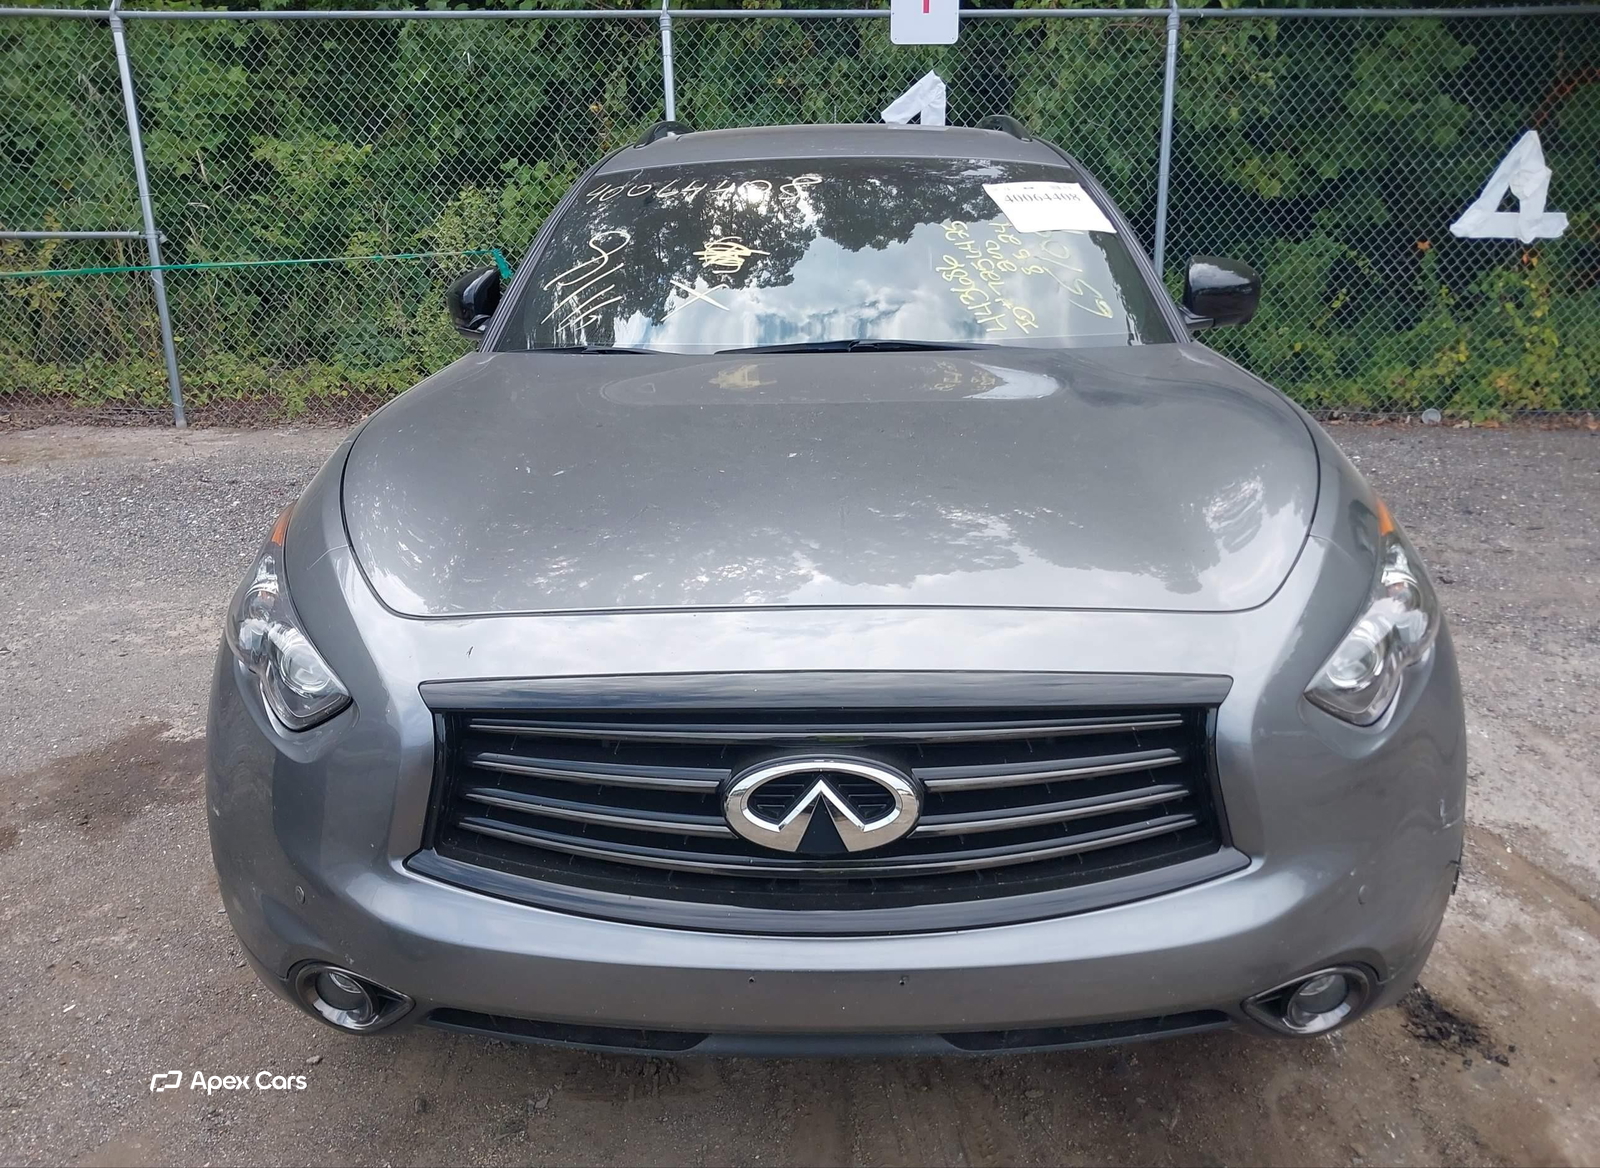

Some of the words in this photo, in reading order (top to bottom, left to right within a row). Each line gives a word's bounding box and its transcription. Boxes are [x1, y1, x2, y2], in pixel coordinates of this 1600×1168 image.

[585, 176, 823, 204] 40064408
[1004, 192, 1081, 204] 40064408
[1449, 130, 1569, 244] 4
